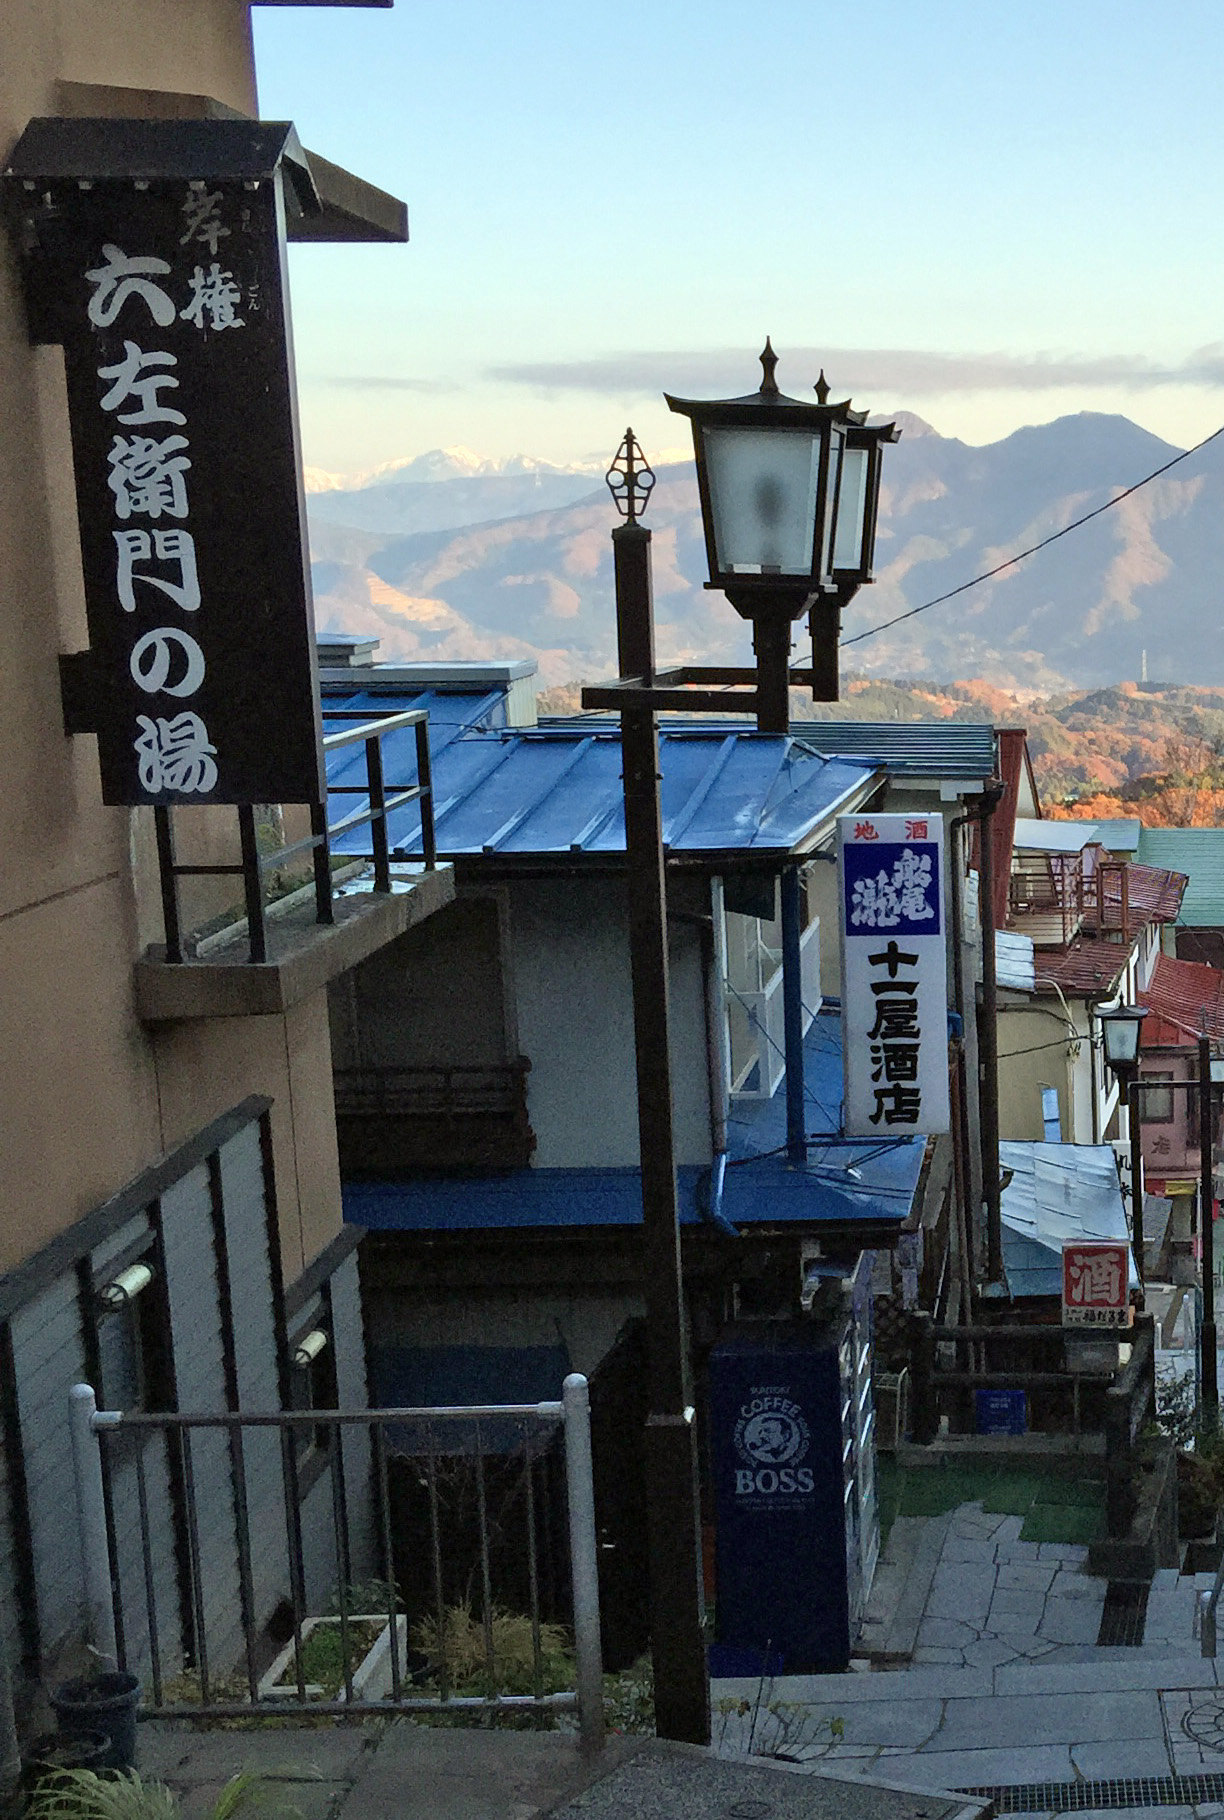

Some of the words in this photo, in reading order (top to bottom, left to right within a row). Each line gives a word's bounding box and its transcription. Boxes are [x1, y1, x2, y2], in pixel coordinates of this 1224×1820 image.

[179, 190, 246, 331] 岸権
[85, 243, 218, 794] 六左衛門の湯
[853, 820, 928, 841] 地酒
[867, 941, 922, 1126] 十一屋酒店
[1069, 1252, 1122, 1304] 酒
[740, 1397, 802, 1418] COFFEE
[735, 1467, 815, 1494] BOSS
